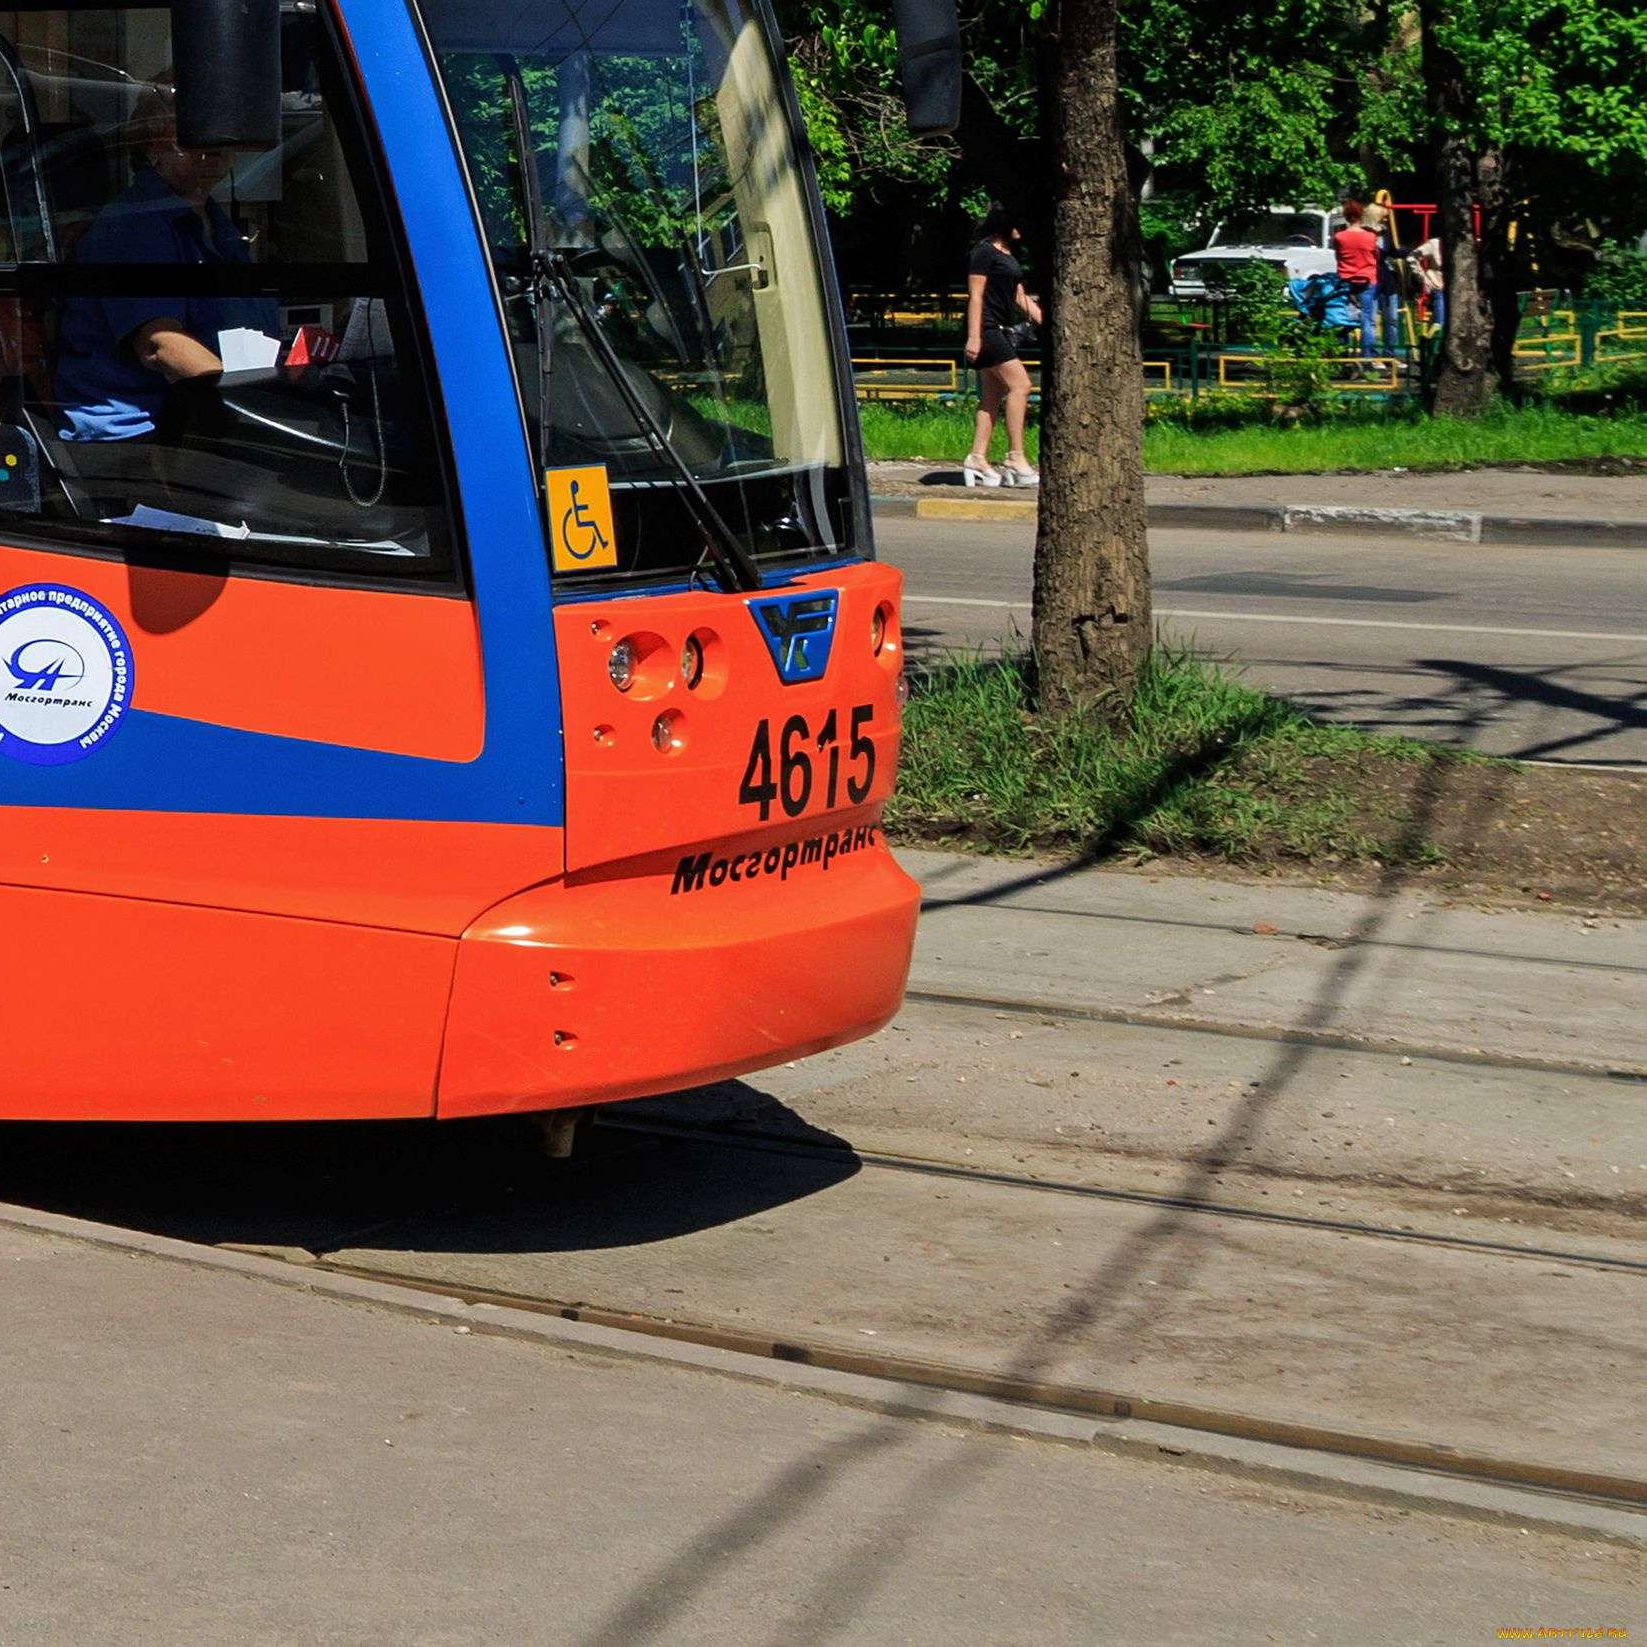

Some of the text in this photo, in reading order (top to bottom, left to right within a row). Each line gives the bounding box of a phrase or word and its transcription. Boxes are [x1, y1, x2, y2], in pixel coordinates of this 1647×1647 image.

[48, 590, 122, 650] предприятие
[4, 692, 93, 708] Мосгортранс
[113, 650, 127, 703] города
[79, 703, 123, 749] Москвы
[738, 703, 876, 822] 4615
[670, 822, 879, 895] Мосгортранс
